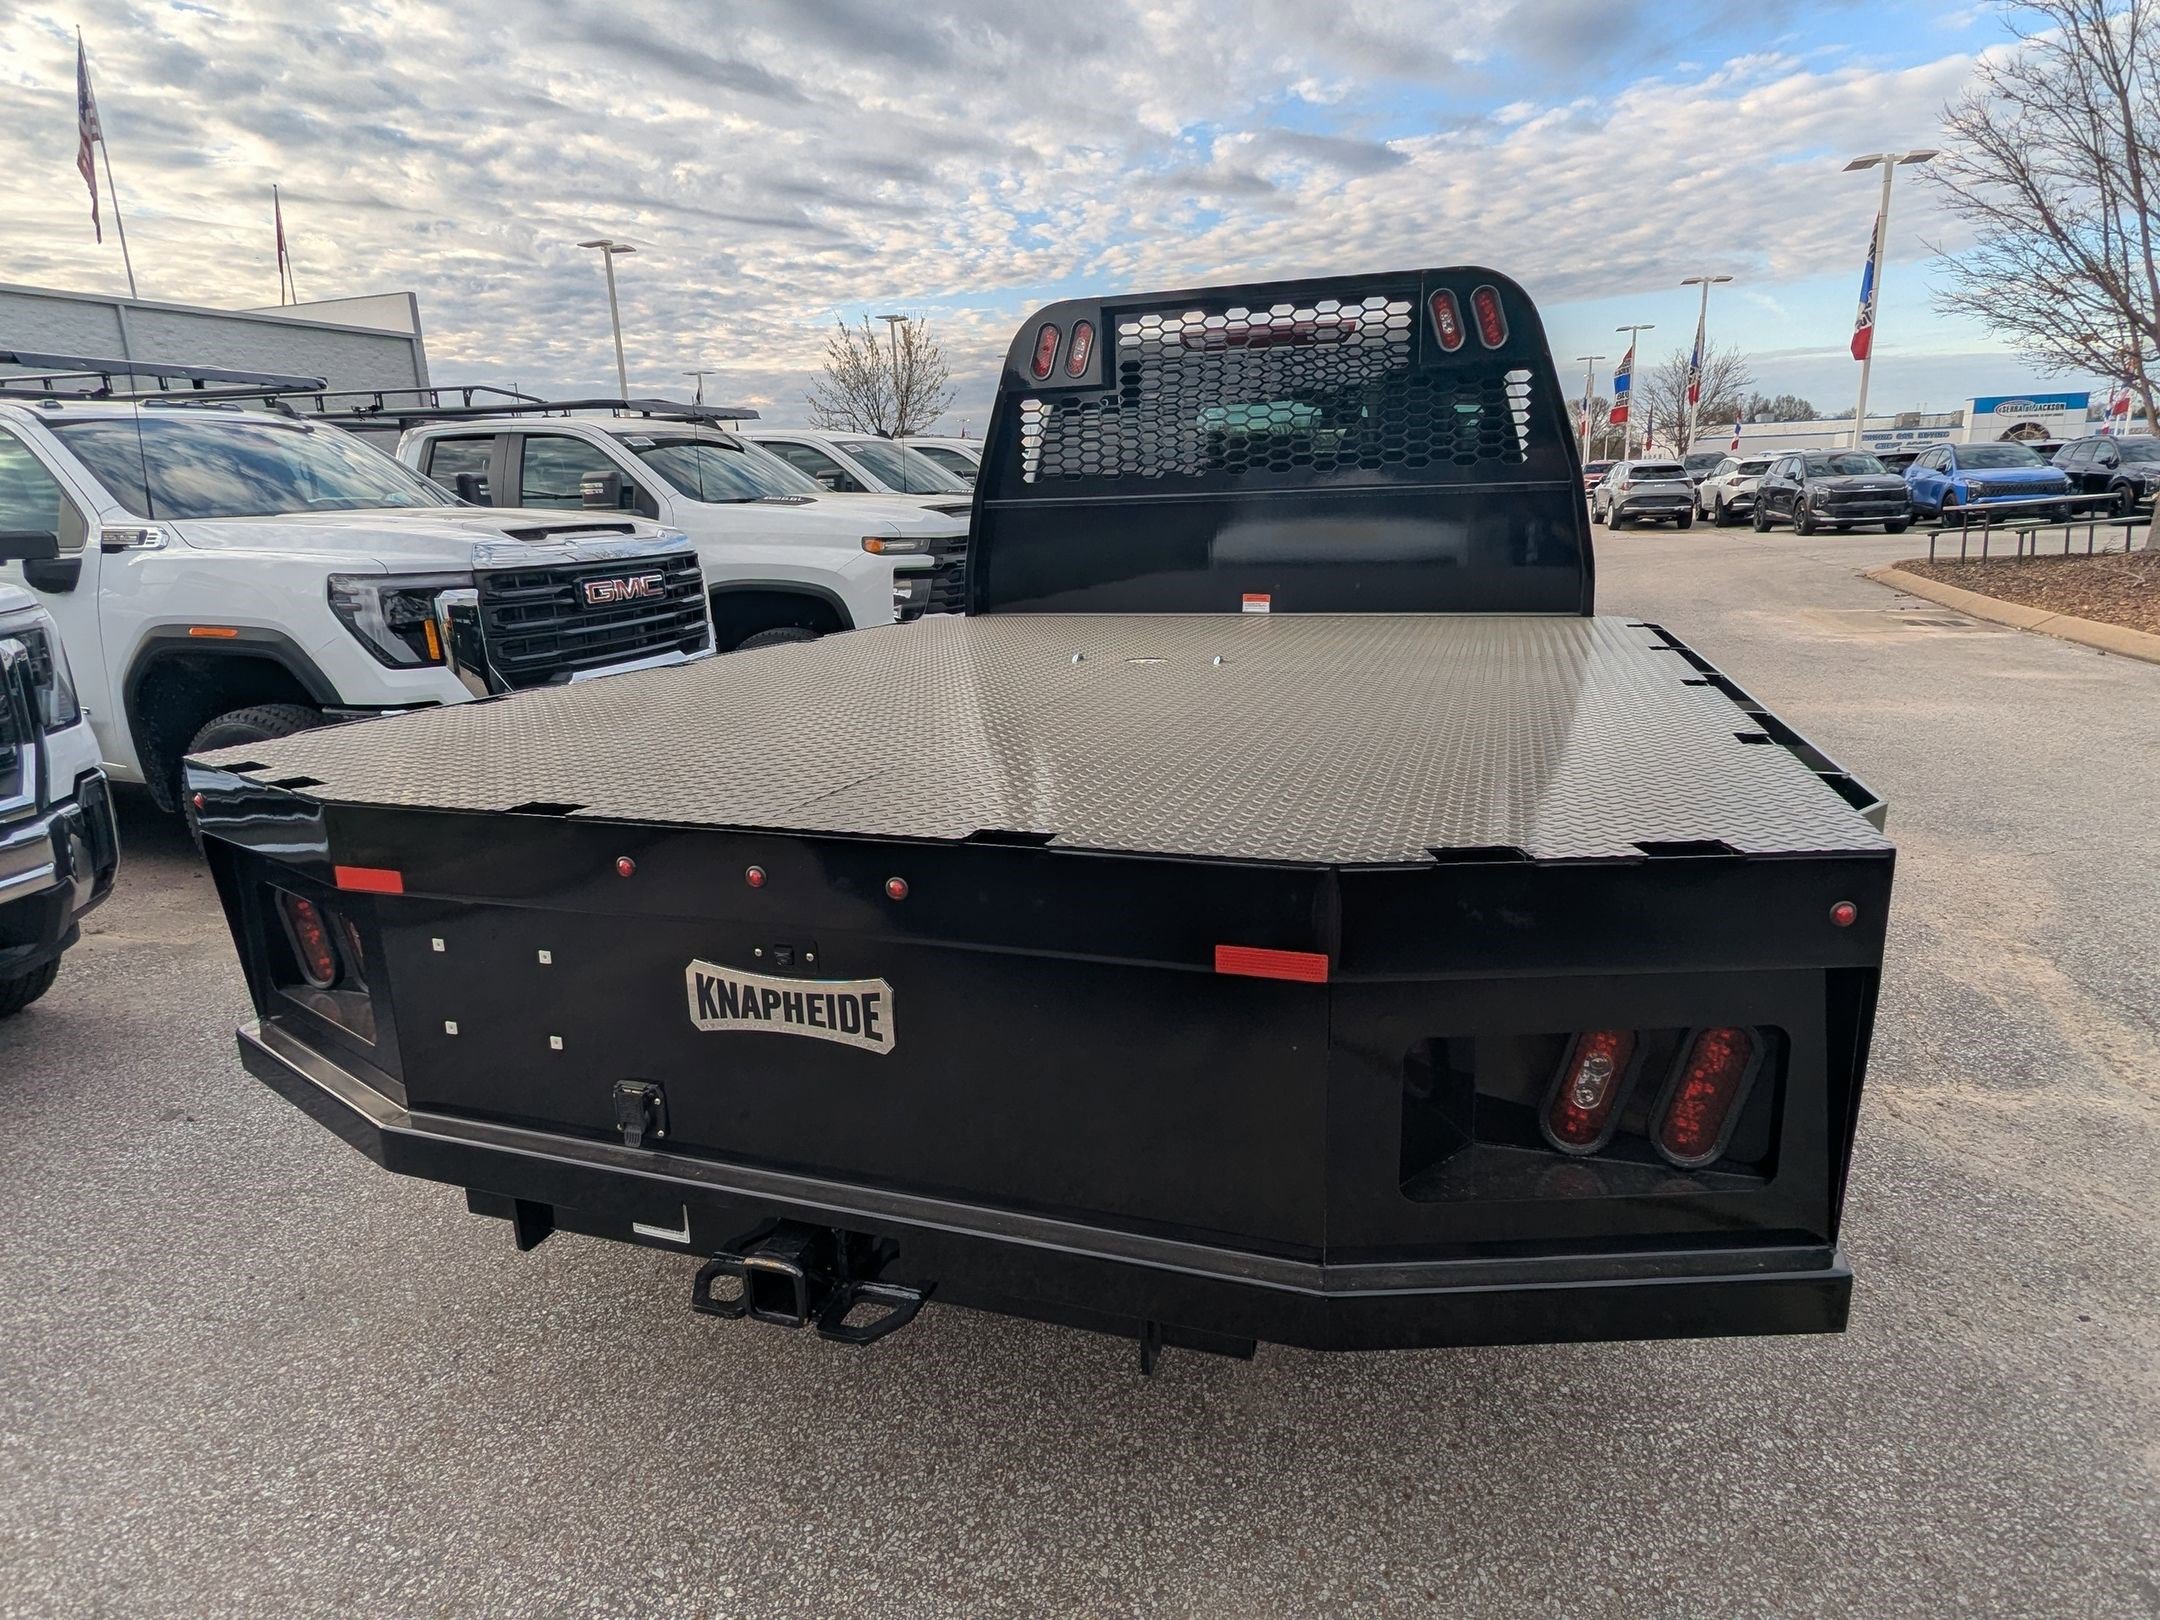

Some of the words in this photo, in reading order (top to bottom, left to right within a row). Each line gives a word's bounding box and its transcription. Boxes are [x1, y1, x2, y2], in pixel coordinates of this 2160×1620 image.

[2033, 403, 2065, 412] JACKSON
[584, 574, 664, 604] GMC
[695, 972, 884, 1042] KNAPHEIDE
